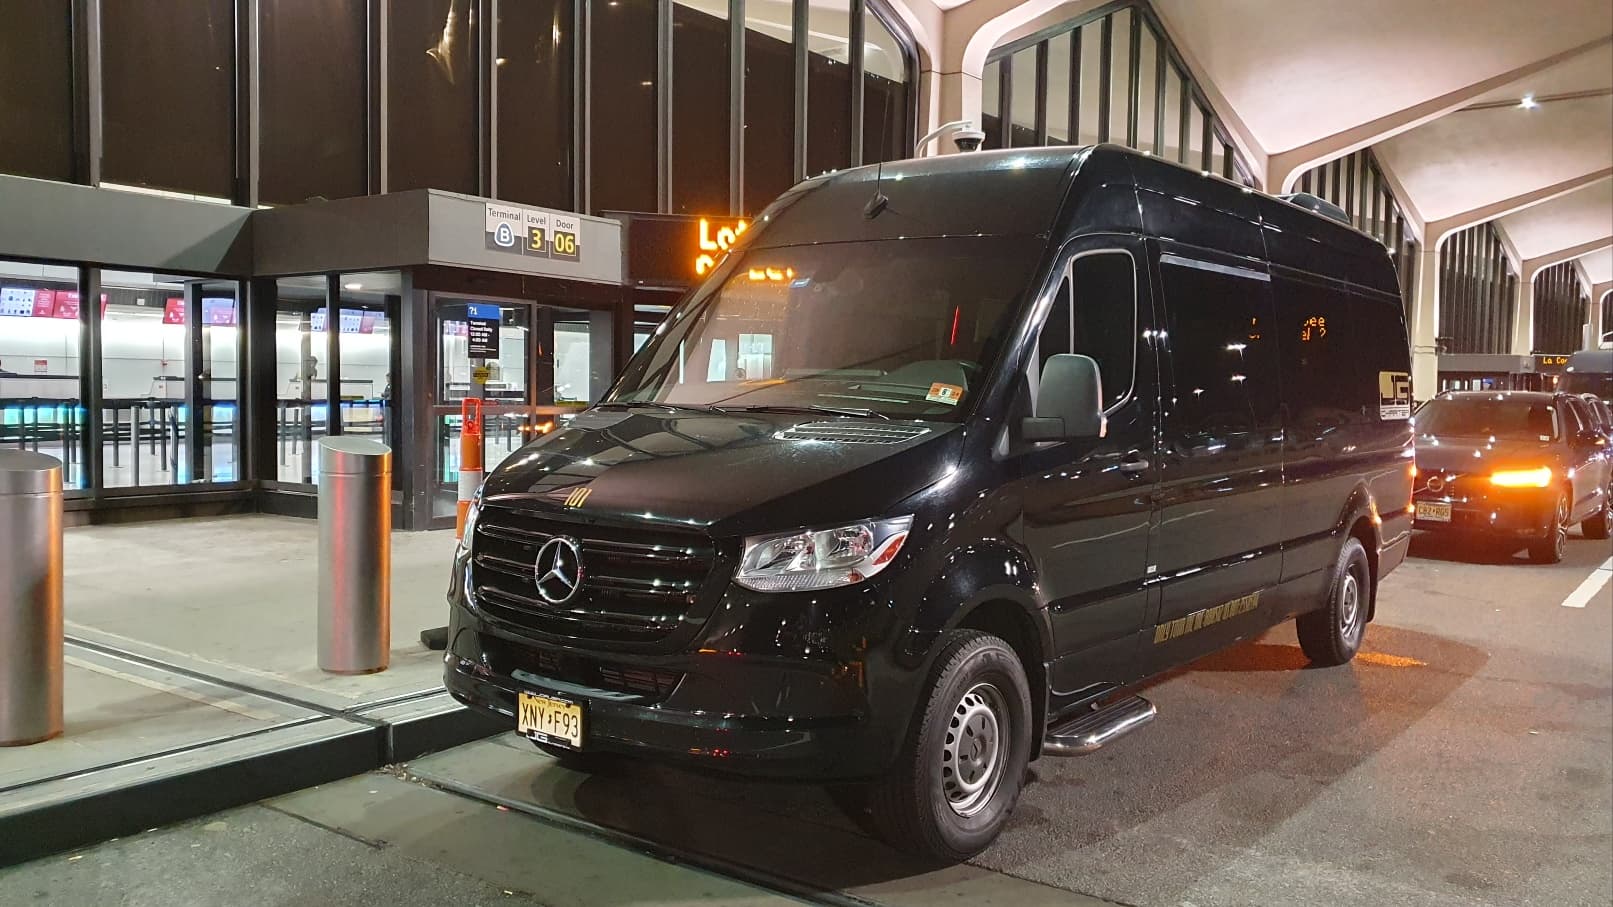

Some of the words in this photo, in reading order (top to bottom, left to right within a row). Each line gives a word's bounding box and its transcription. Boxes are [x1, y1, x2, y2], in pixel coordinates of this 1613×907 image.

[488, 208, 521, 221] Terminal
[527, 215, 546, 225] Level
[556, 219, 574, 230] Door
[500, 227, 510, 242] B
[531, 229, 542, 249] 3
[555, 233, 575, 253] 06
[522, 703, 545, 730] XNY
[554, 711, 579, 738] F93
